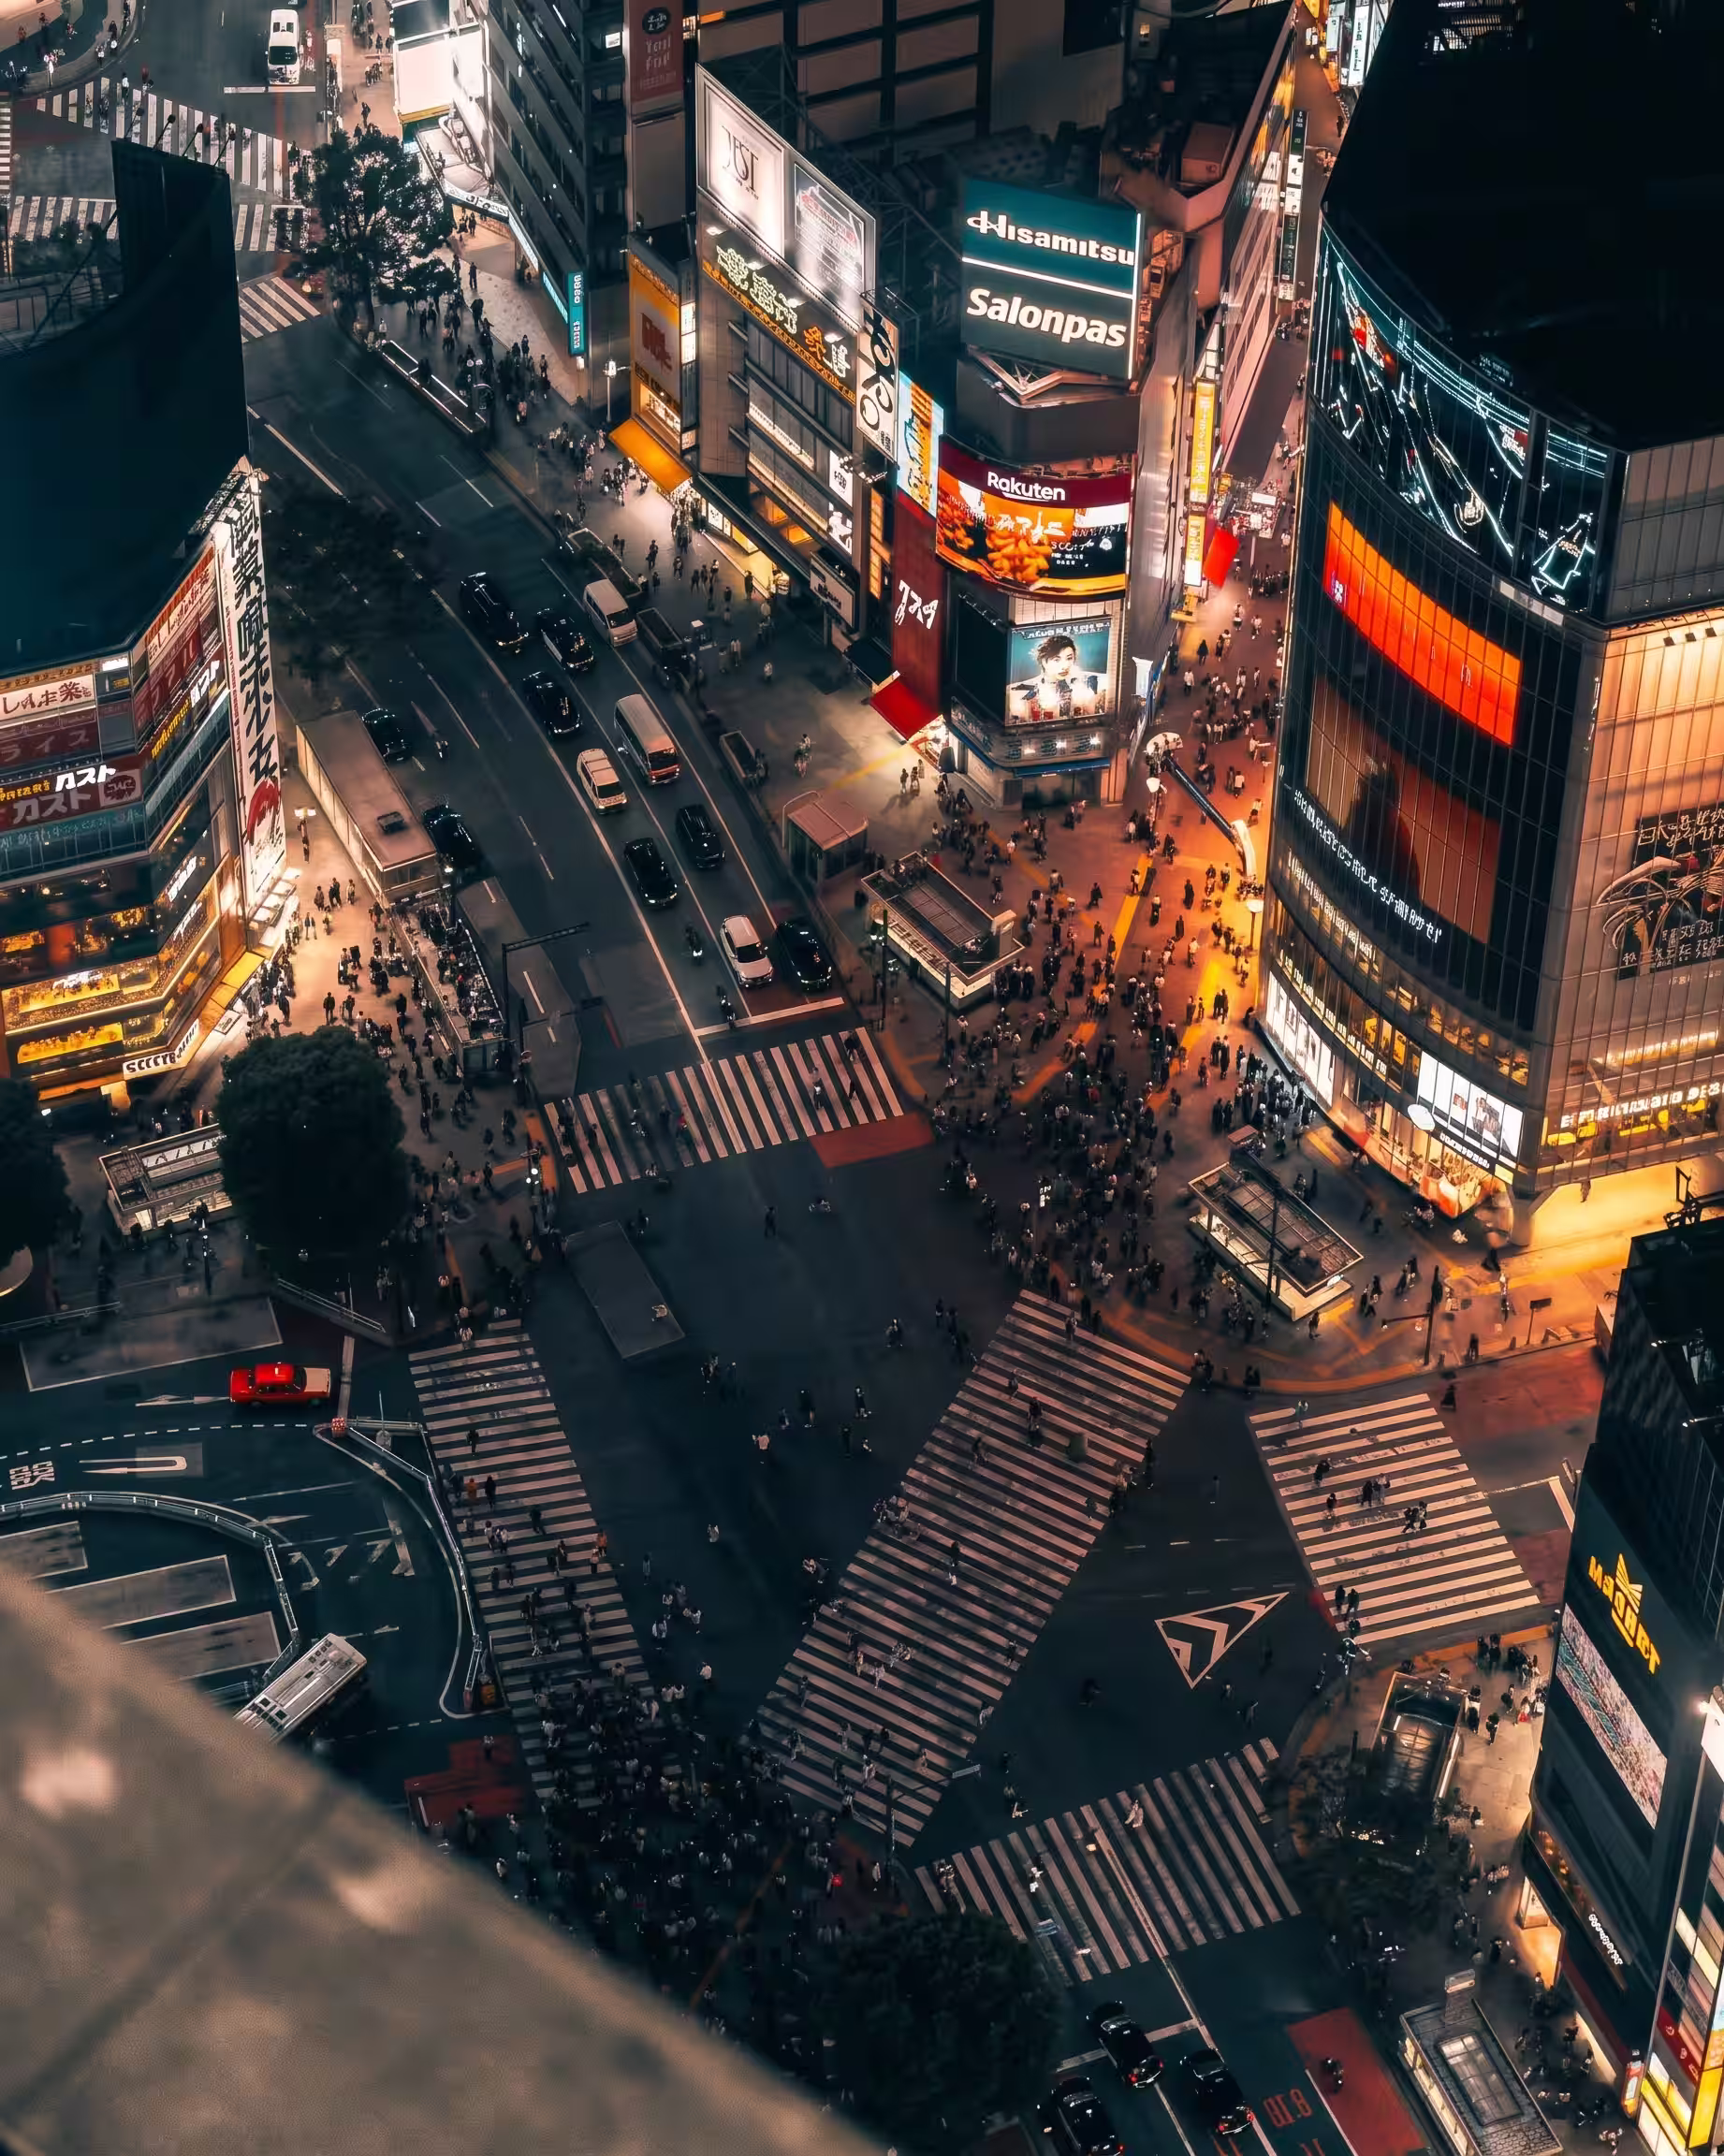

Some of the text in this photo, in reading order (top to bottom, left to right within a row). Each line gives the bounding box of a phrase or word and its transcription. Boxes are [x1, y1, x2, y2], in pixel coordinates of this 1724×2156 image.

[966, 211, 1134, 266] Hisamitsu
[966, 288, 1127, 347] Salonpas
[987, 471, 1066, 502] Rakuten
